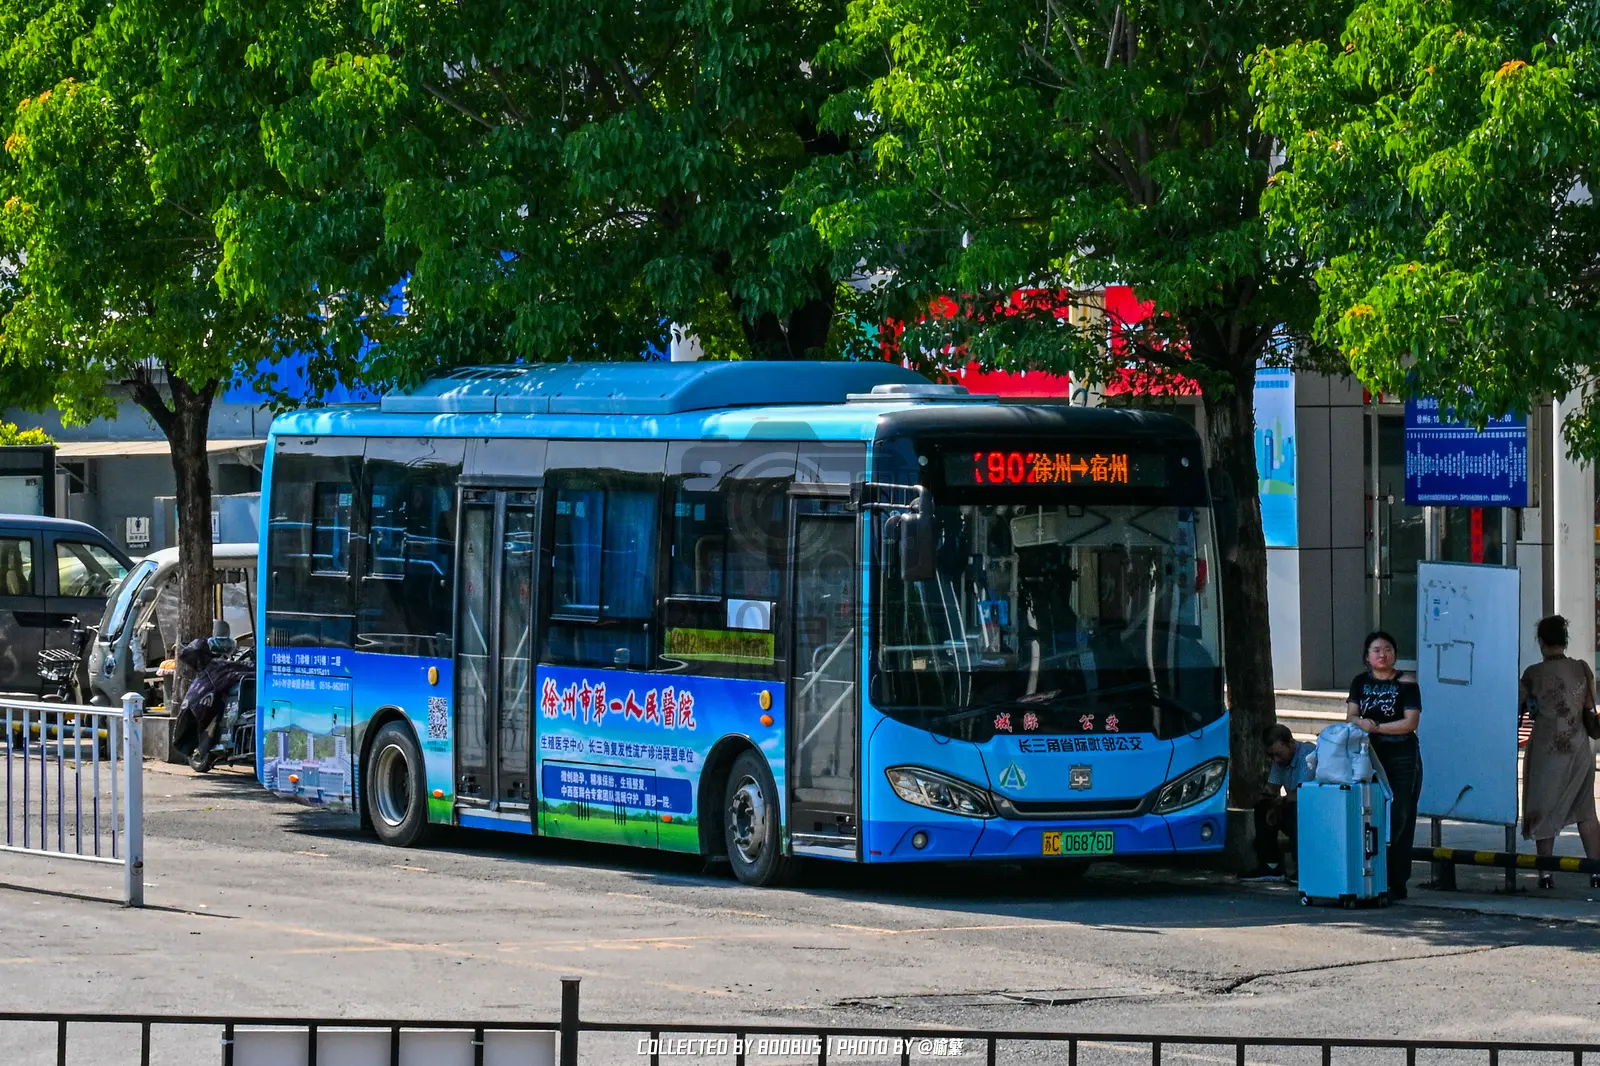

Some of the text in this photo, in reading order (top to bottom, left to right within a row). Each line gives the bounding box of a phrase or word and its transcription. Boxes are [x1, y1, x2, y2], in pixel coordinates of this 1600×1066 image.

[1033, 453, 1072, 483] 徐州
[1090, 453, 1128, 483] 宿州
[1079, 714, 1119, 732] 公交
[541, 735, 584, 752] 生殖医学中心
[1065, 834, 1113, 852] 06876D
